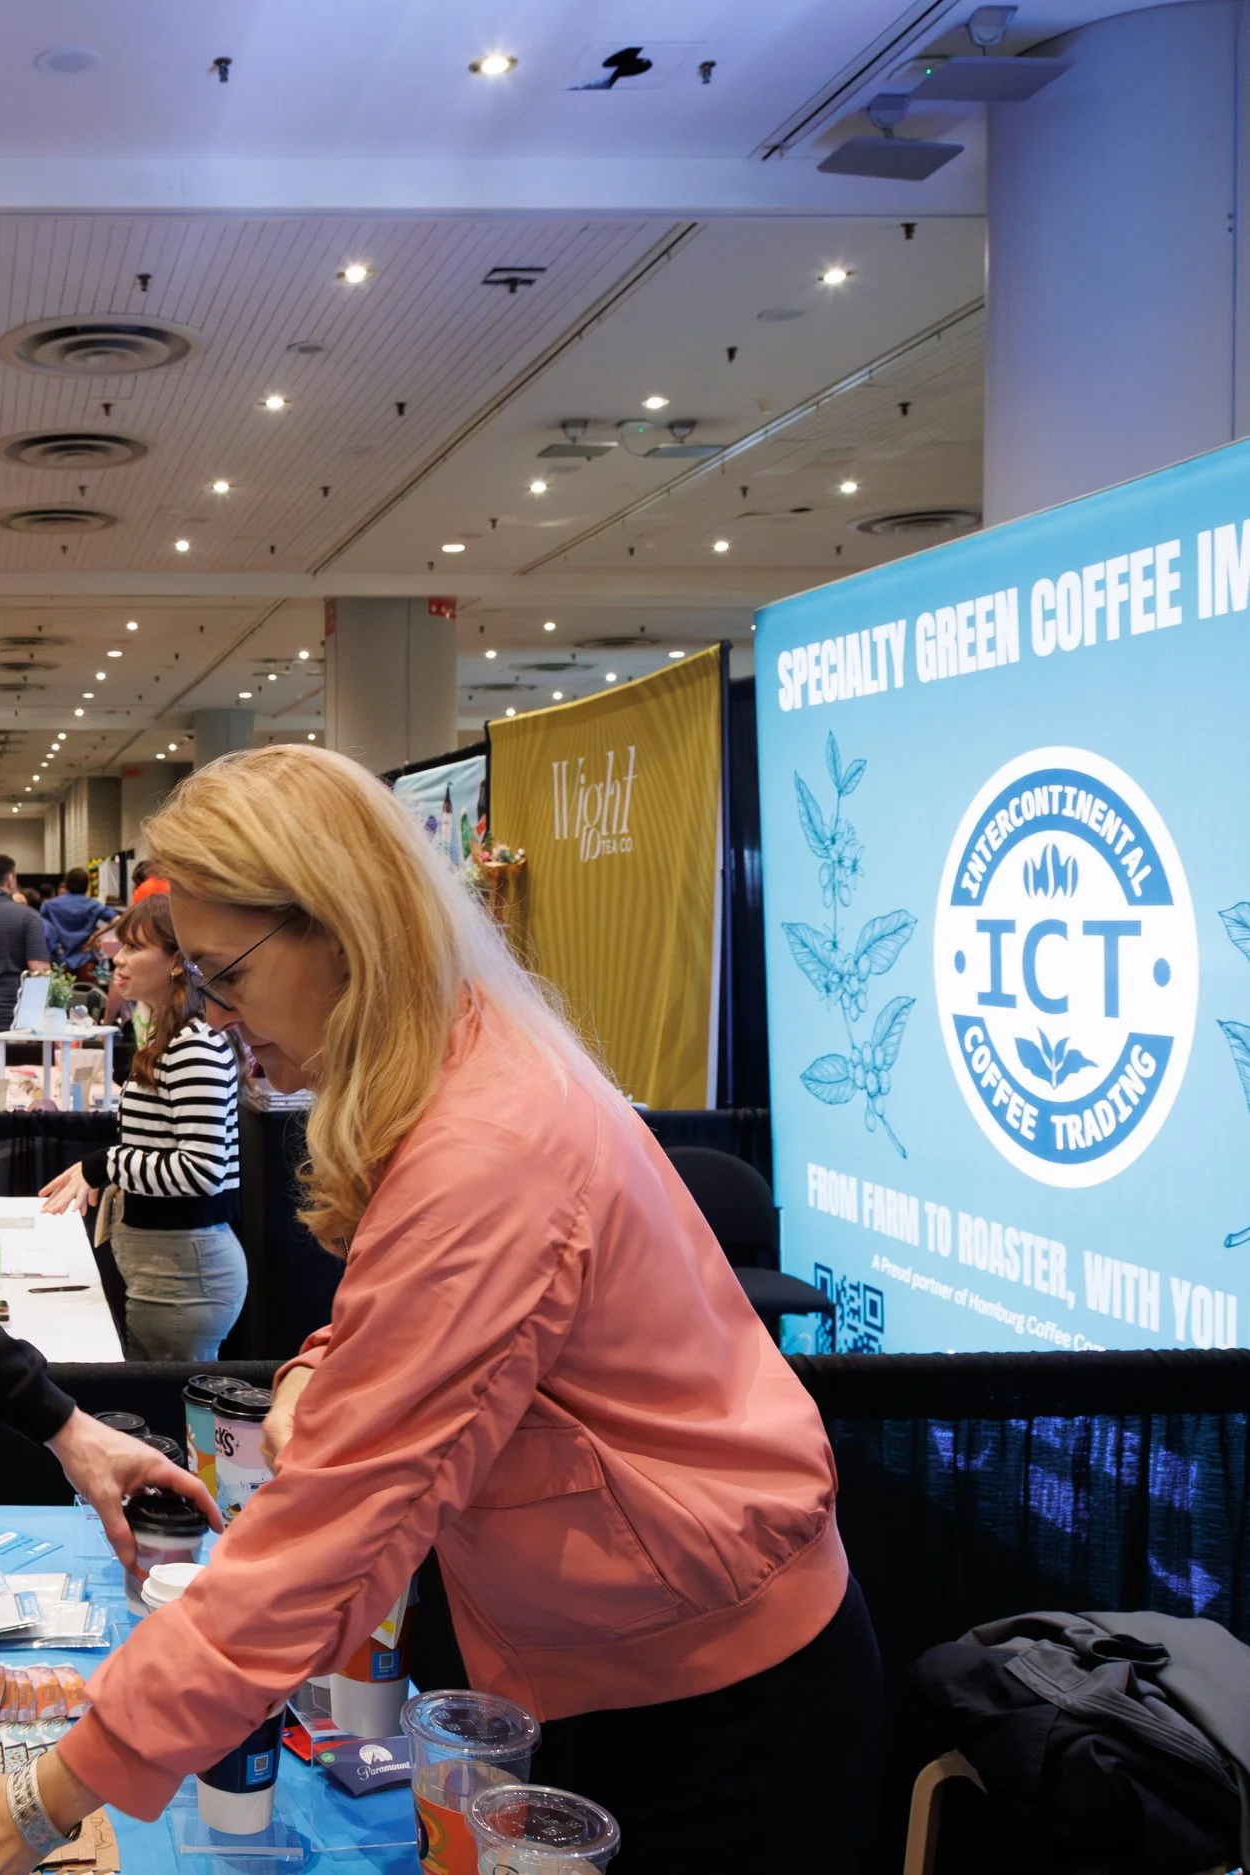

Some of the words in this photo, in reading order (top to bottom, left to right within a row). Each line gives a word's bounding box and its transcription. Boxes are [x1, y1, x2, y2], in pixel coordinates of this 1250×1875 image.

[777, 619, 907, 712] SPECIALTY
[915, 587, 1020, 684] GREEN
[1030, 538, 1183, 658] COFFEE
[1197, 518, 1250, 620] IM
[552, 745, 638, 862] Wight
[601, 839, 617, 855] TEA
[960, 784, 1152, 899] INTERCONTINENTAL
[976, 918, 1142, 1019] ICT
[963, 1025, 1039, 1140] COFFEE
[1051, 1044, 1157, 1150] TRADING
[807, 1162, 858, 1224] FROM
[862, 1181, 920, 1247] FARM
[924, 1200, 952, 1258] TO
[957, 1211, 1075, 1310] ROASTER,
[1083, 1250, 1160, 1333] WITH
[1169, 1276, 1238, 1350] YOU
[871, 1253, 880, 1271] A
[881, 1256, 912, 1284] Proud
[911, 1272, 954, 1300] partner
[954, 1288, 968, 1306] of
[1026, 1315, 1072, 1348] Coffee
[357, 1761, 411, 1781] Paramount
